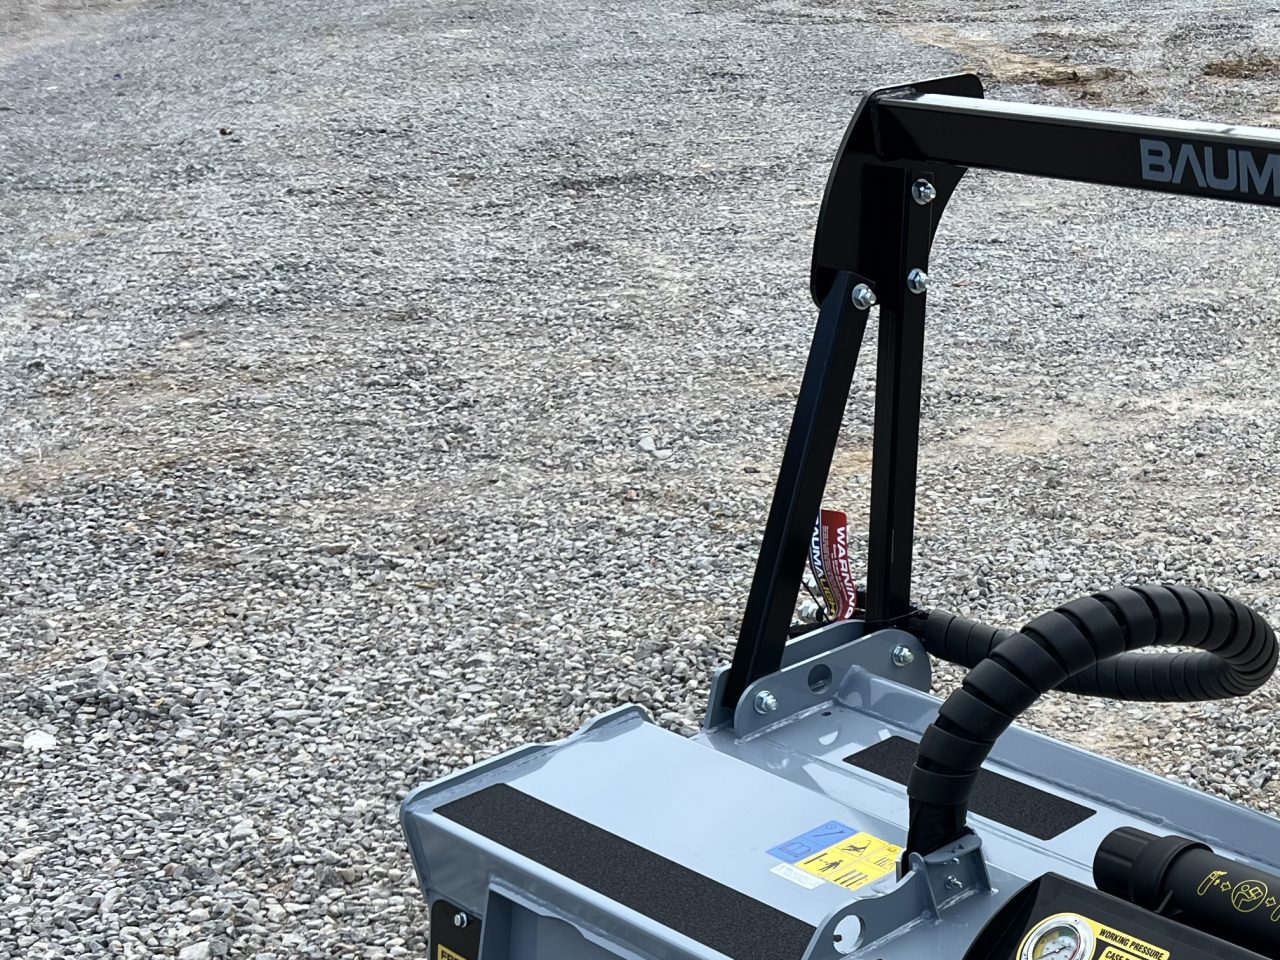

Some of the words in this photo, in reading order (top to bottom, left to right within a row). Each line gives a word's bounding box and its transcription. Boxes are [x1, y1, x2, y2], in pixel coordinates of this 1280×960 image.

[836, 525, 857, 619] WARNING
[1099, 928, 1130, 946] WORKING
[1129, 941, 1164, 960] PRESSURE
